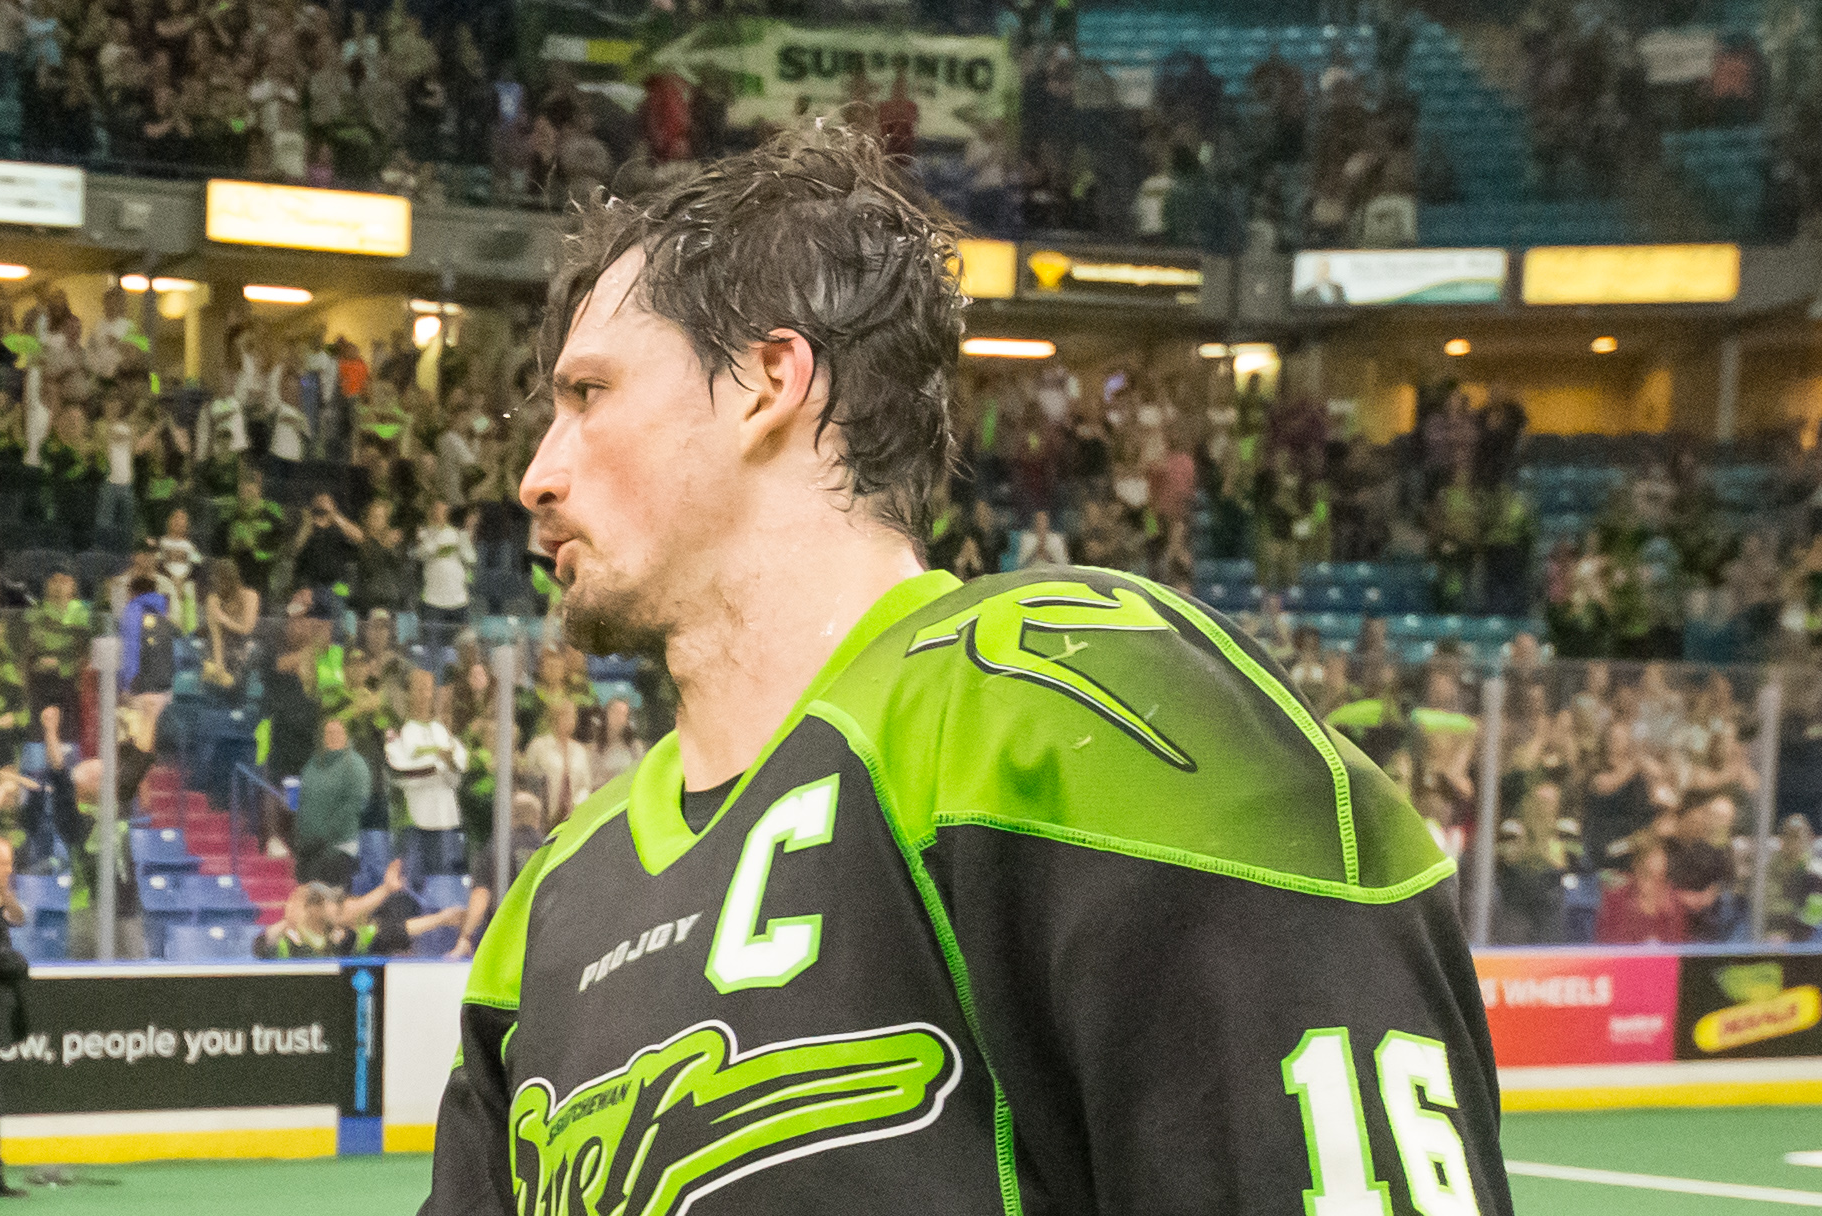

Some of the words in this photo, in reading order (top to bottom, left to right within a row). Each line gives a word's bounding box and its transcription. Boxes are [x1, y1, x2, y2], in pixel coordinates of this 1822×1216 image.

[704, 772, 841, 995] C
[62, 1024, 176, 1066] people
[183, 1029, 244, 1064] you
[250, 1022, 329, 1055] trust.
